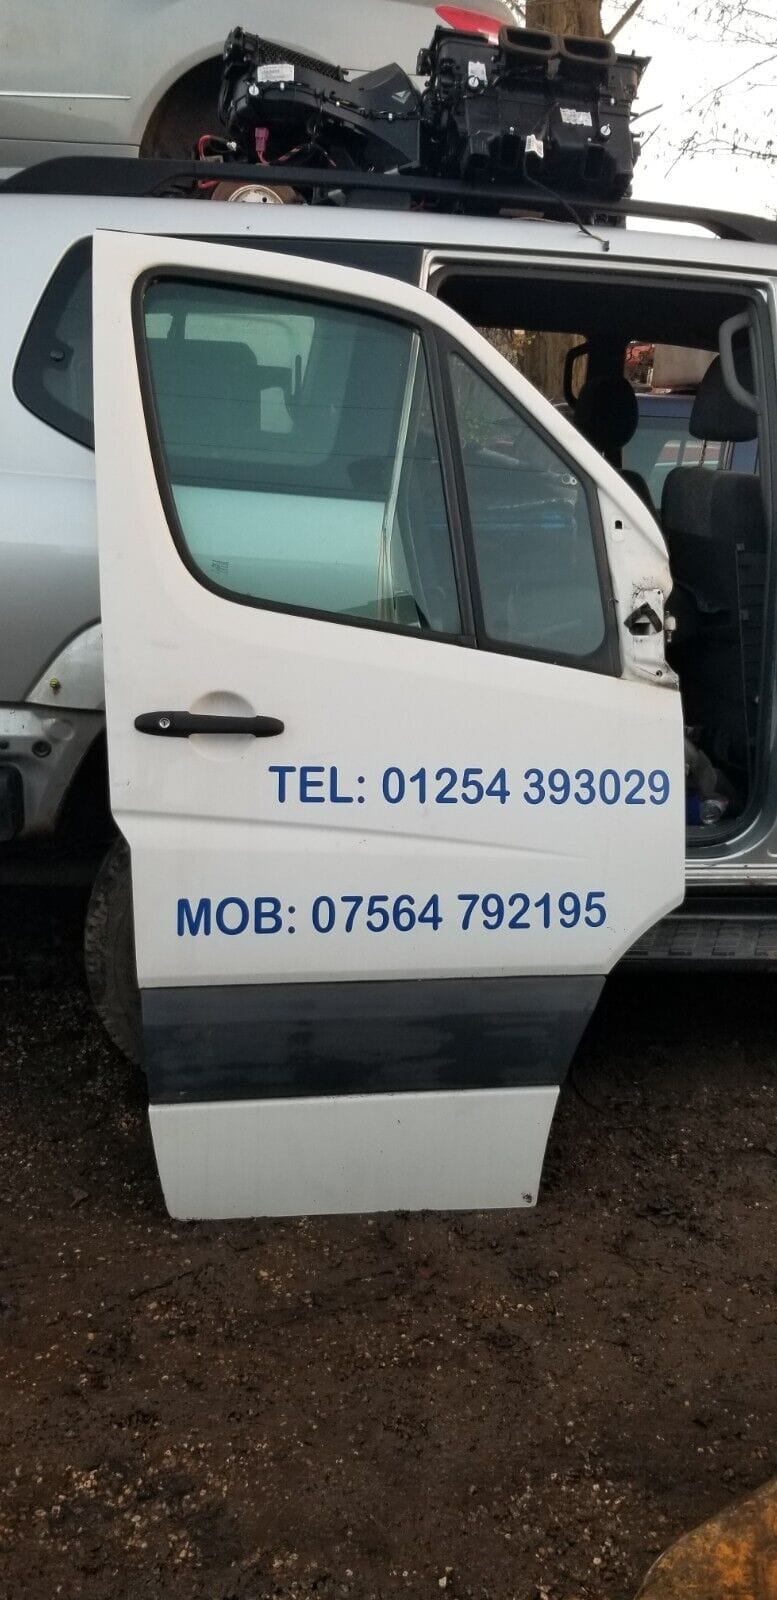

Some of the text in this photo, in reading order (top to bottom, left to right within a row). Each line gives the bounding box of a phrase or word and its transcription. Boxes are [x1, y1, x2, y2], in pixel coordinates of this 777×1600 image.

[268, 765, 671, 805] TEL: 01254 393029
[176, 891, 608, 937] MOB: 07564 792195
